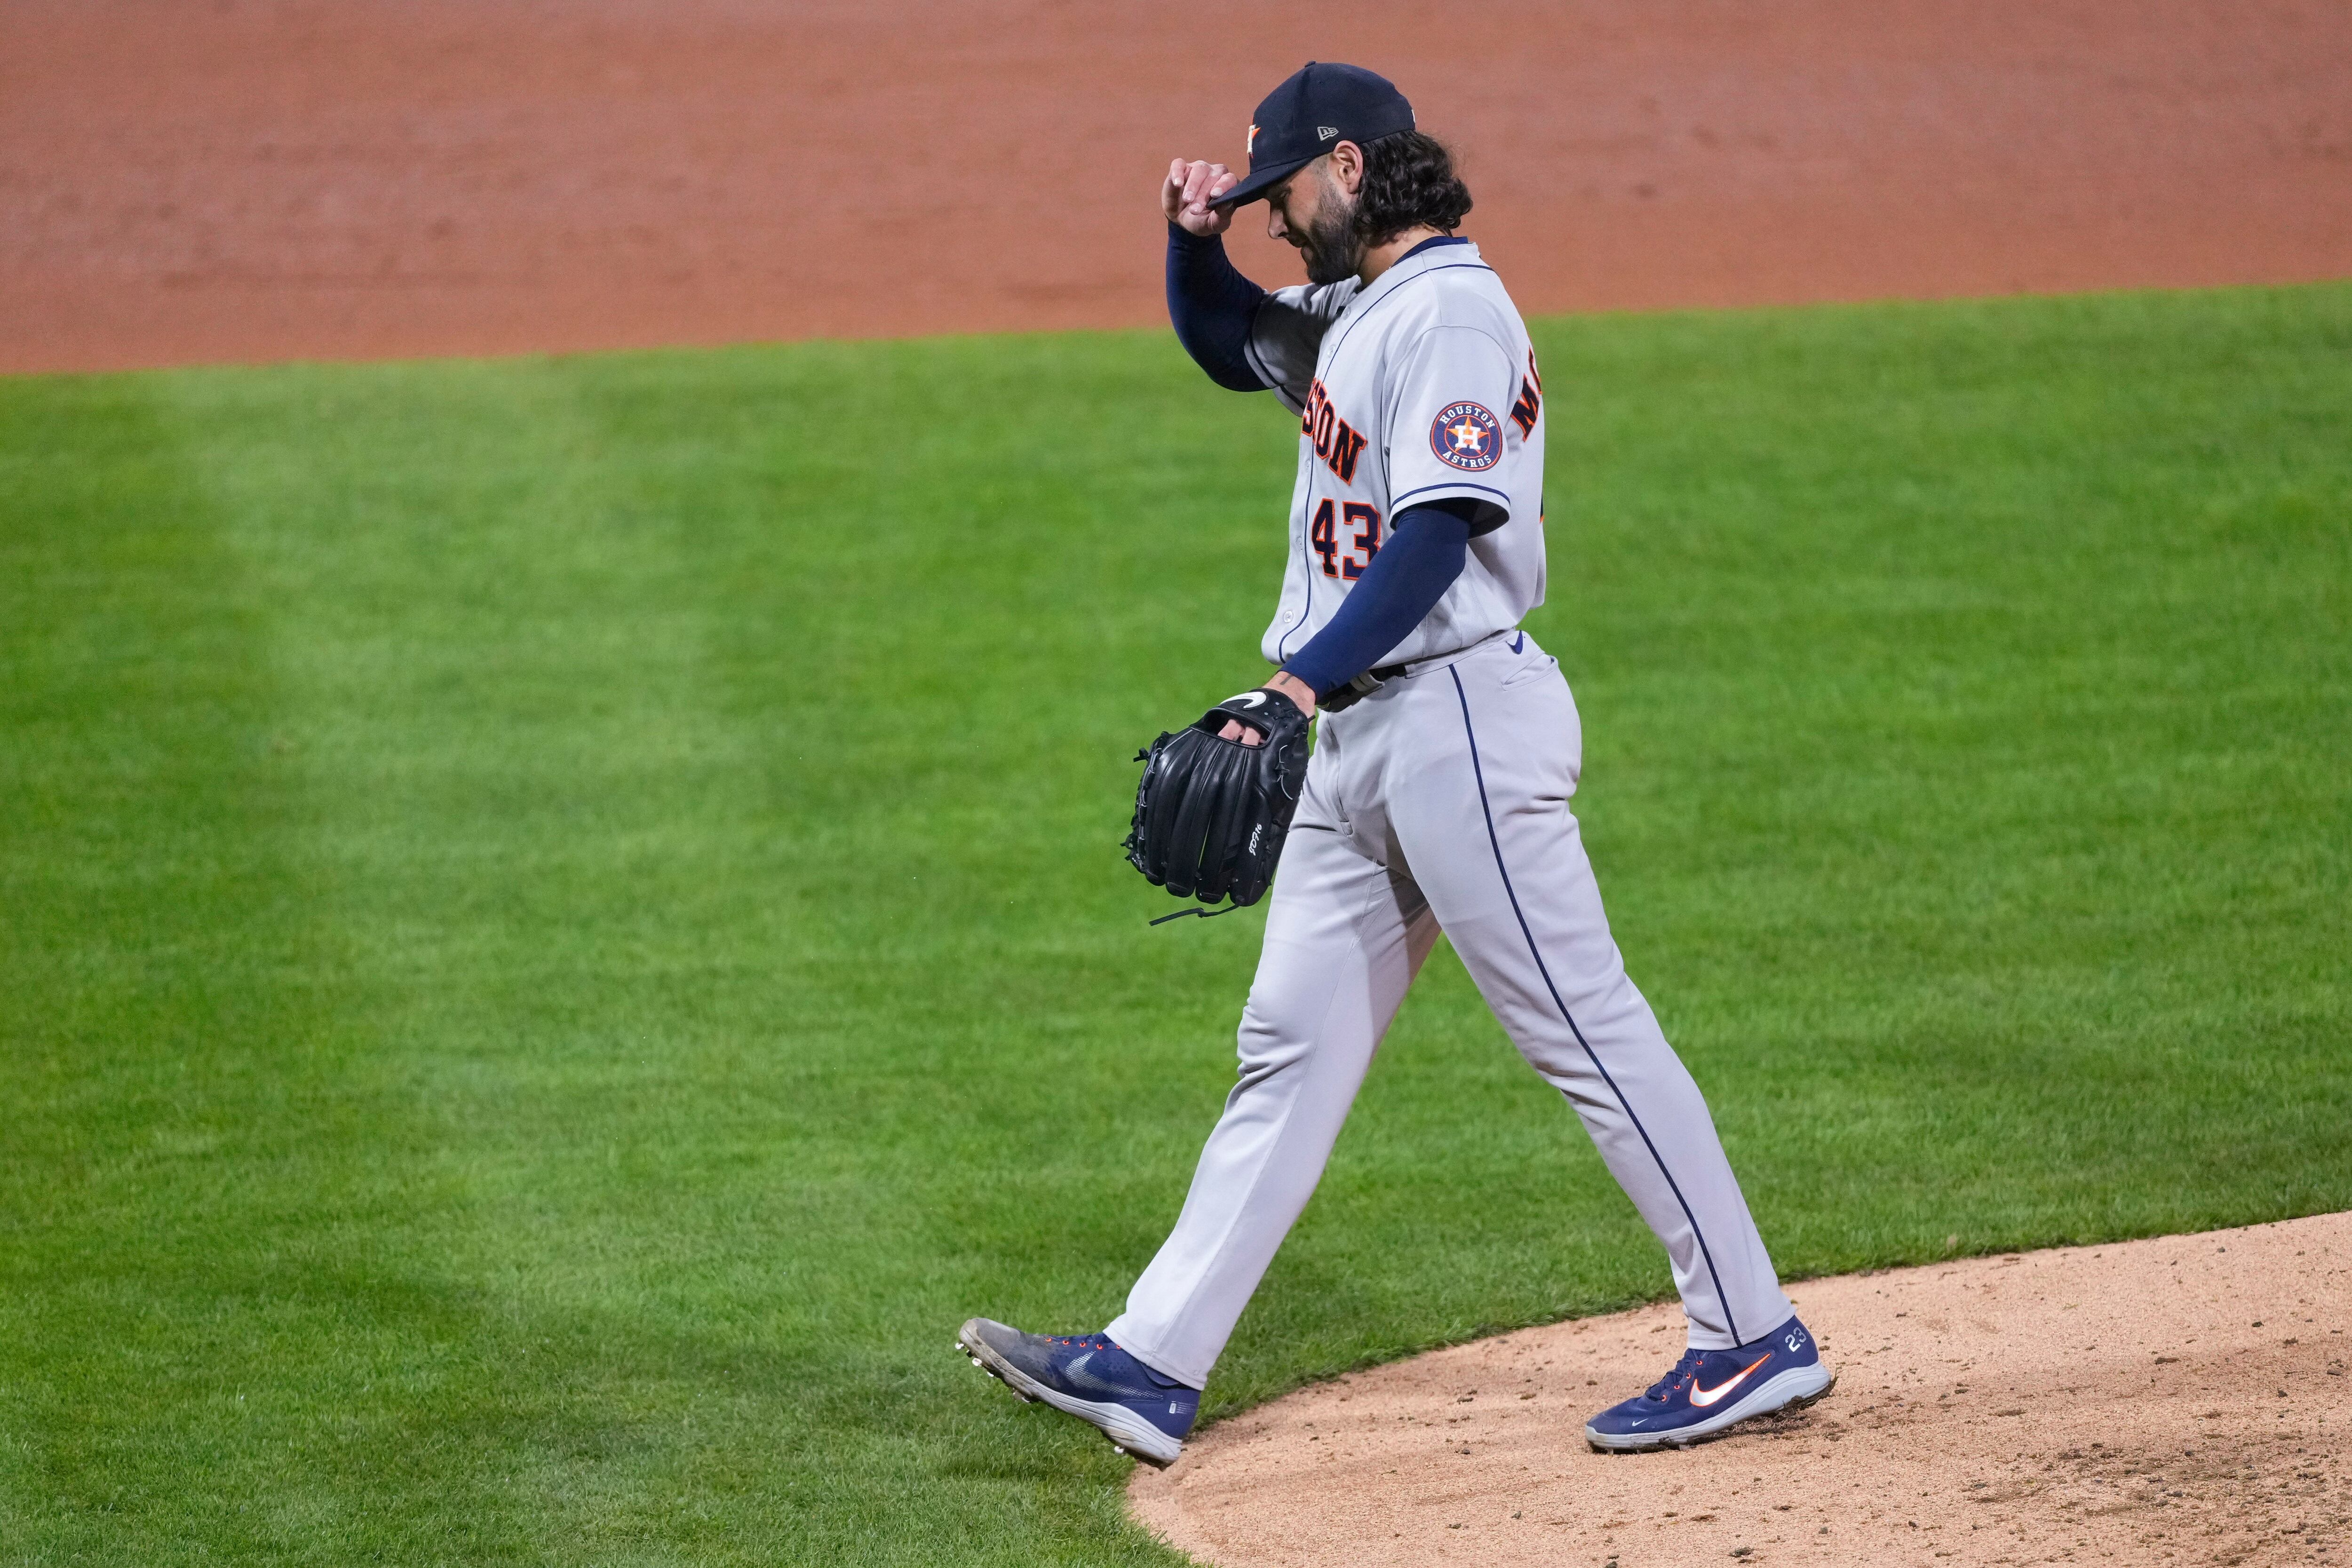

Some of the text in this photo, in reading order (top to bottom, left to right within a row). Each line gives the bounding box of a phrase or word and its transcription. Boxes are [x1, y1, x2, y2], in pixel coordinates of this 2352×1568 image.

[1439, 406, 1495, 428] HOUSTON
[1299, 378, 1368, 486] STON
[1454, 425, 1482, 450] H
[1442, 451, 1491, 467] ASTROS
[1311, 498, 1381, 580] 43
[1785, 1327, 1806, 1352] 23
